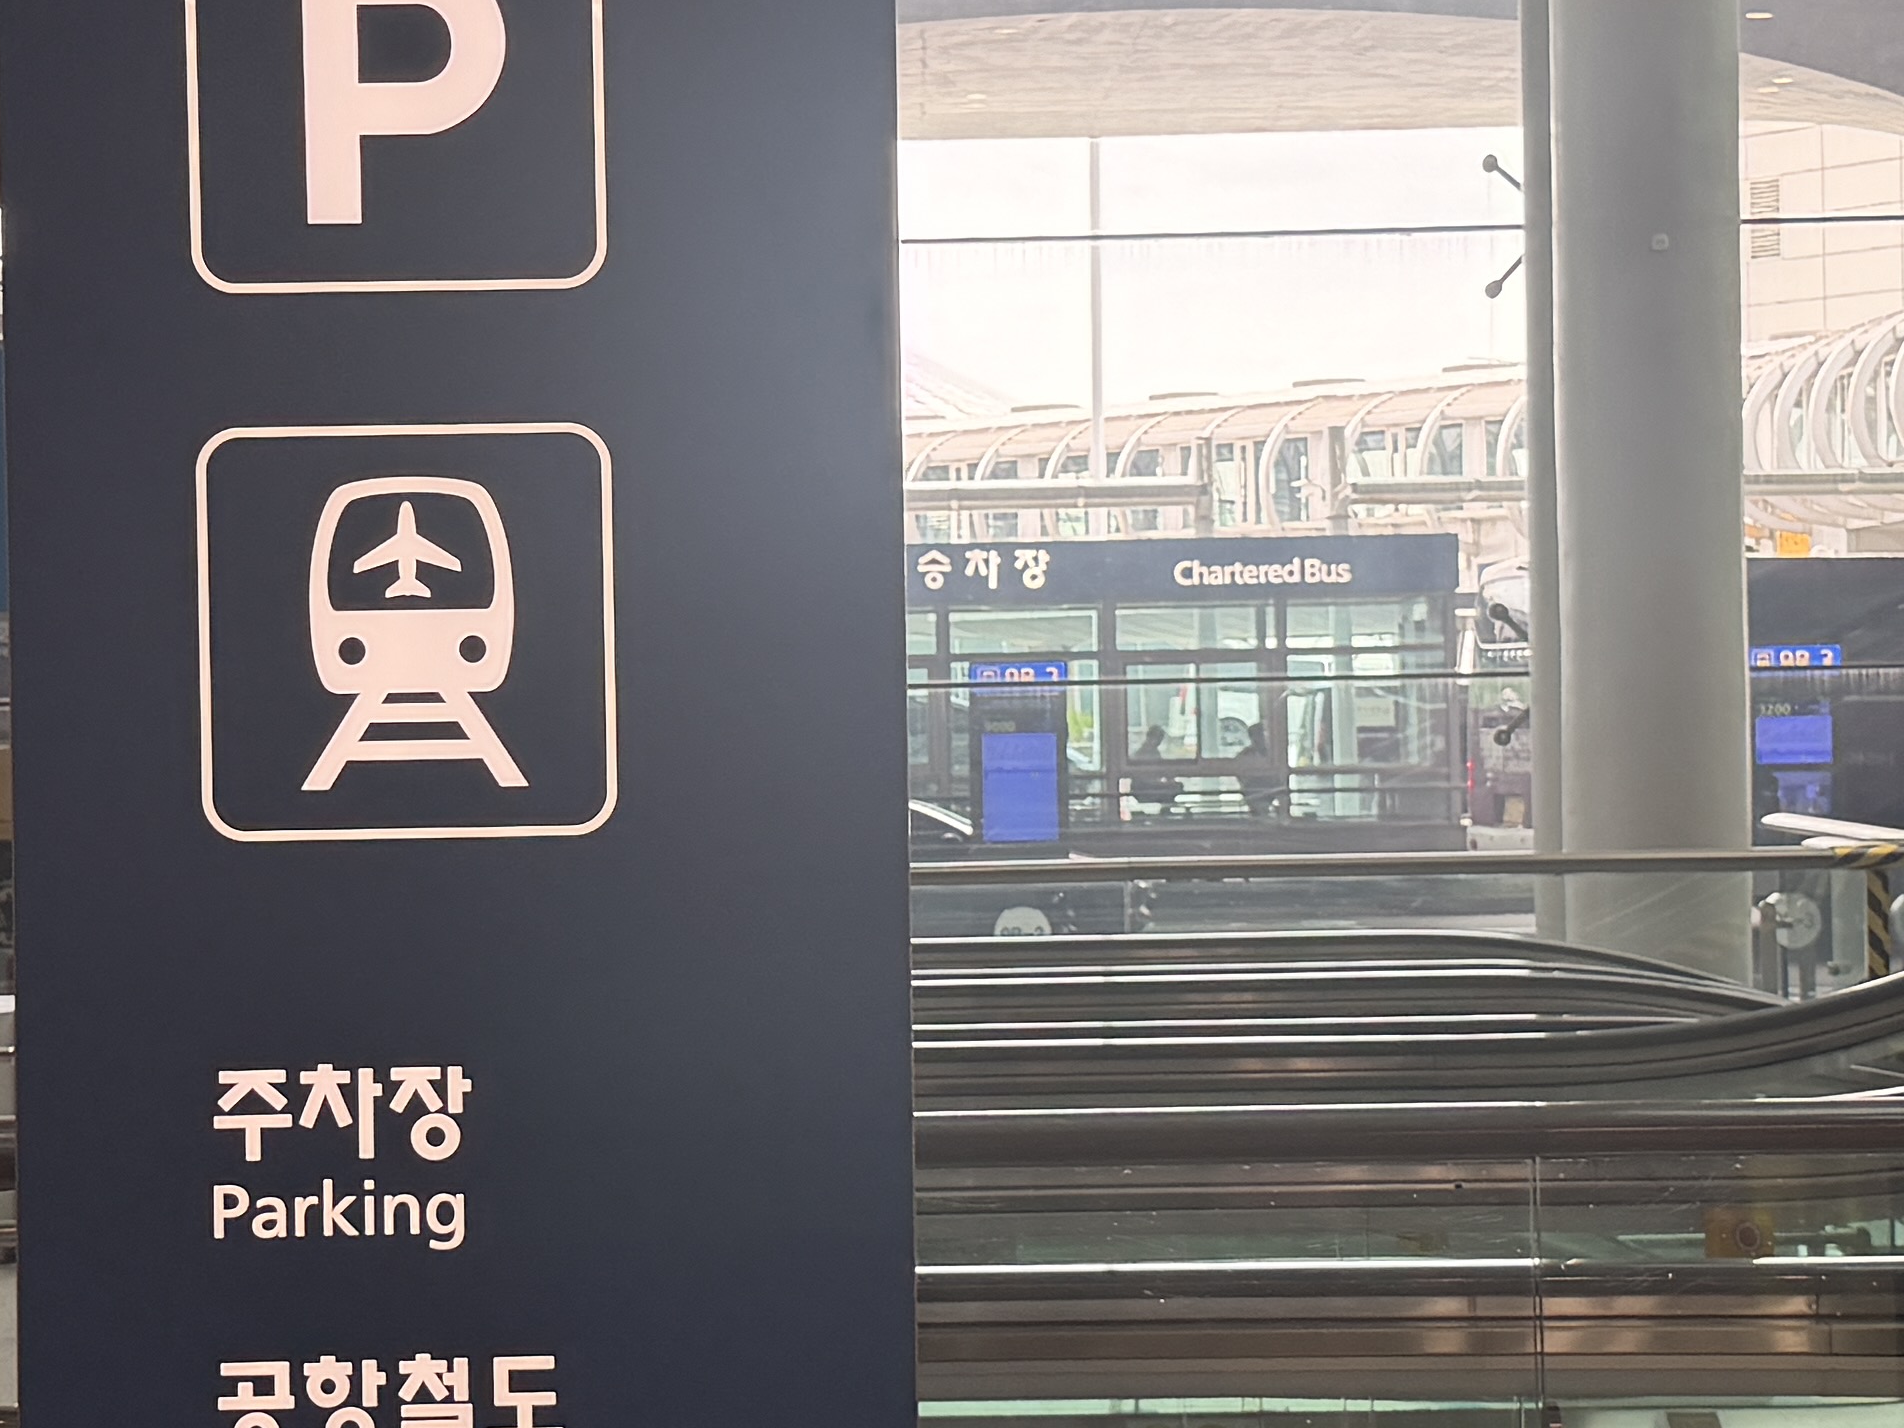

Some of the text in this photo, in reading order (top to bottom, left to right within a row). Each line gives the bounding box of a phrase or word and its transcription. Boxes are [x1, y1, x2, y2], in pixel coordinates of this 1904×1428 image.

[917, 548, 1050, 589] 승차장
[1173, 557, 1352, 586] Chartered Bus
[213, 1063, 472, 1162] 주차장
[212, 1178, 466, 1251] Parking
